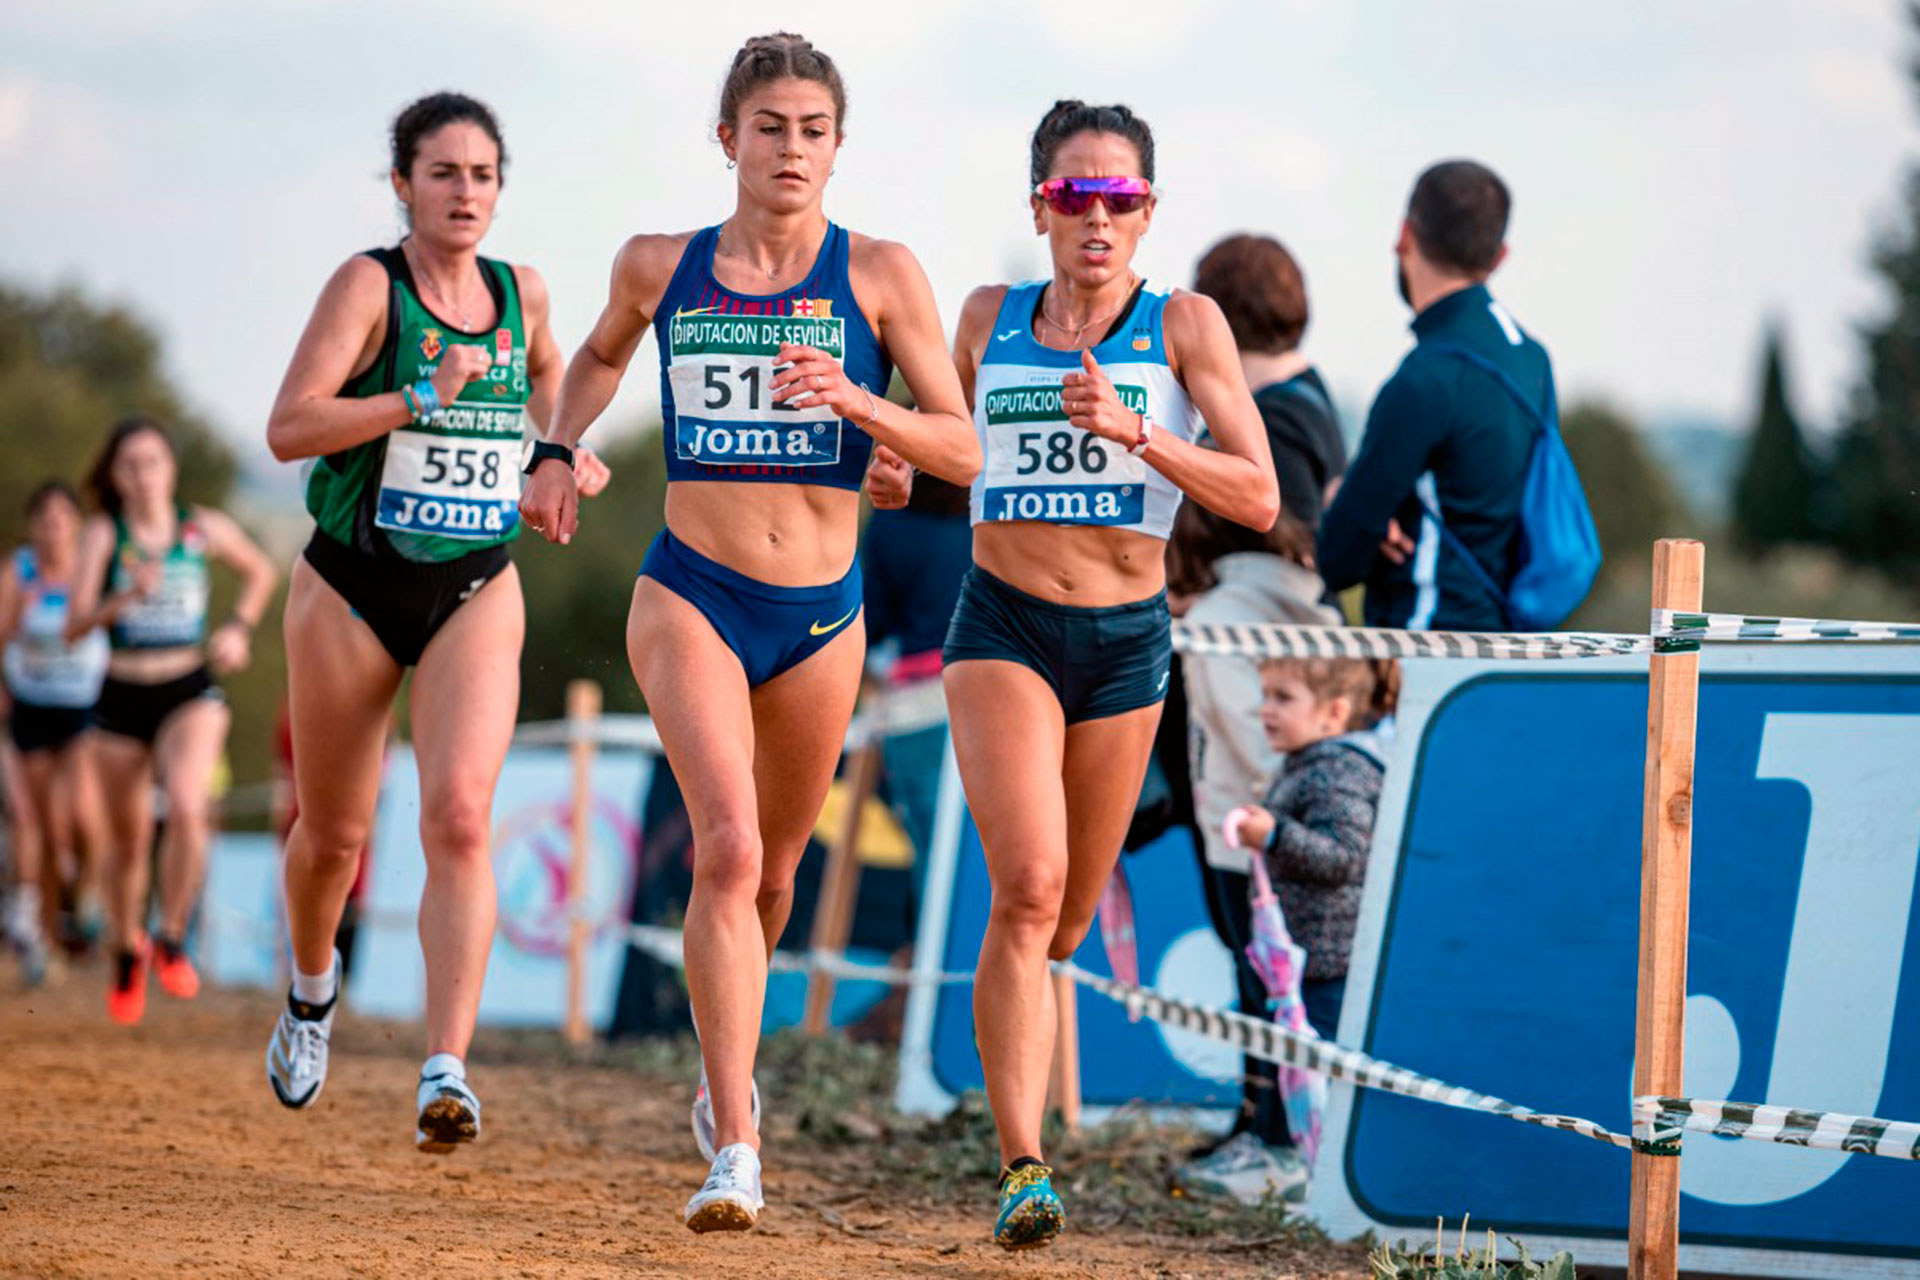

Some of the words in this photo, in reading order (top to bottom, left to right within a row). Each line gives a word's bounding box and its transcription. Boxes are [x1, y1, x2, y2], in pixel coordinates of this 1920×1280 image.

[674, 322, 758, 345] DIPUTACION
[762, 325, 780, 344] DE
[784, 325, 841, 347] SEVILLA
[987, 391, 1063, 415] DIPUTACION
[476, 410, 492, 431] DE
[688, 425, 813, 456] Joma
[1016, 431, 1108, 475] 586
[421, 446, 500, 489] 558
[395, 497, 503, 531] Joma
[998, 490, 1121, 521] Joma
